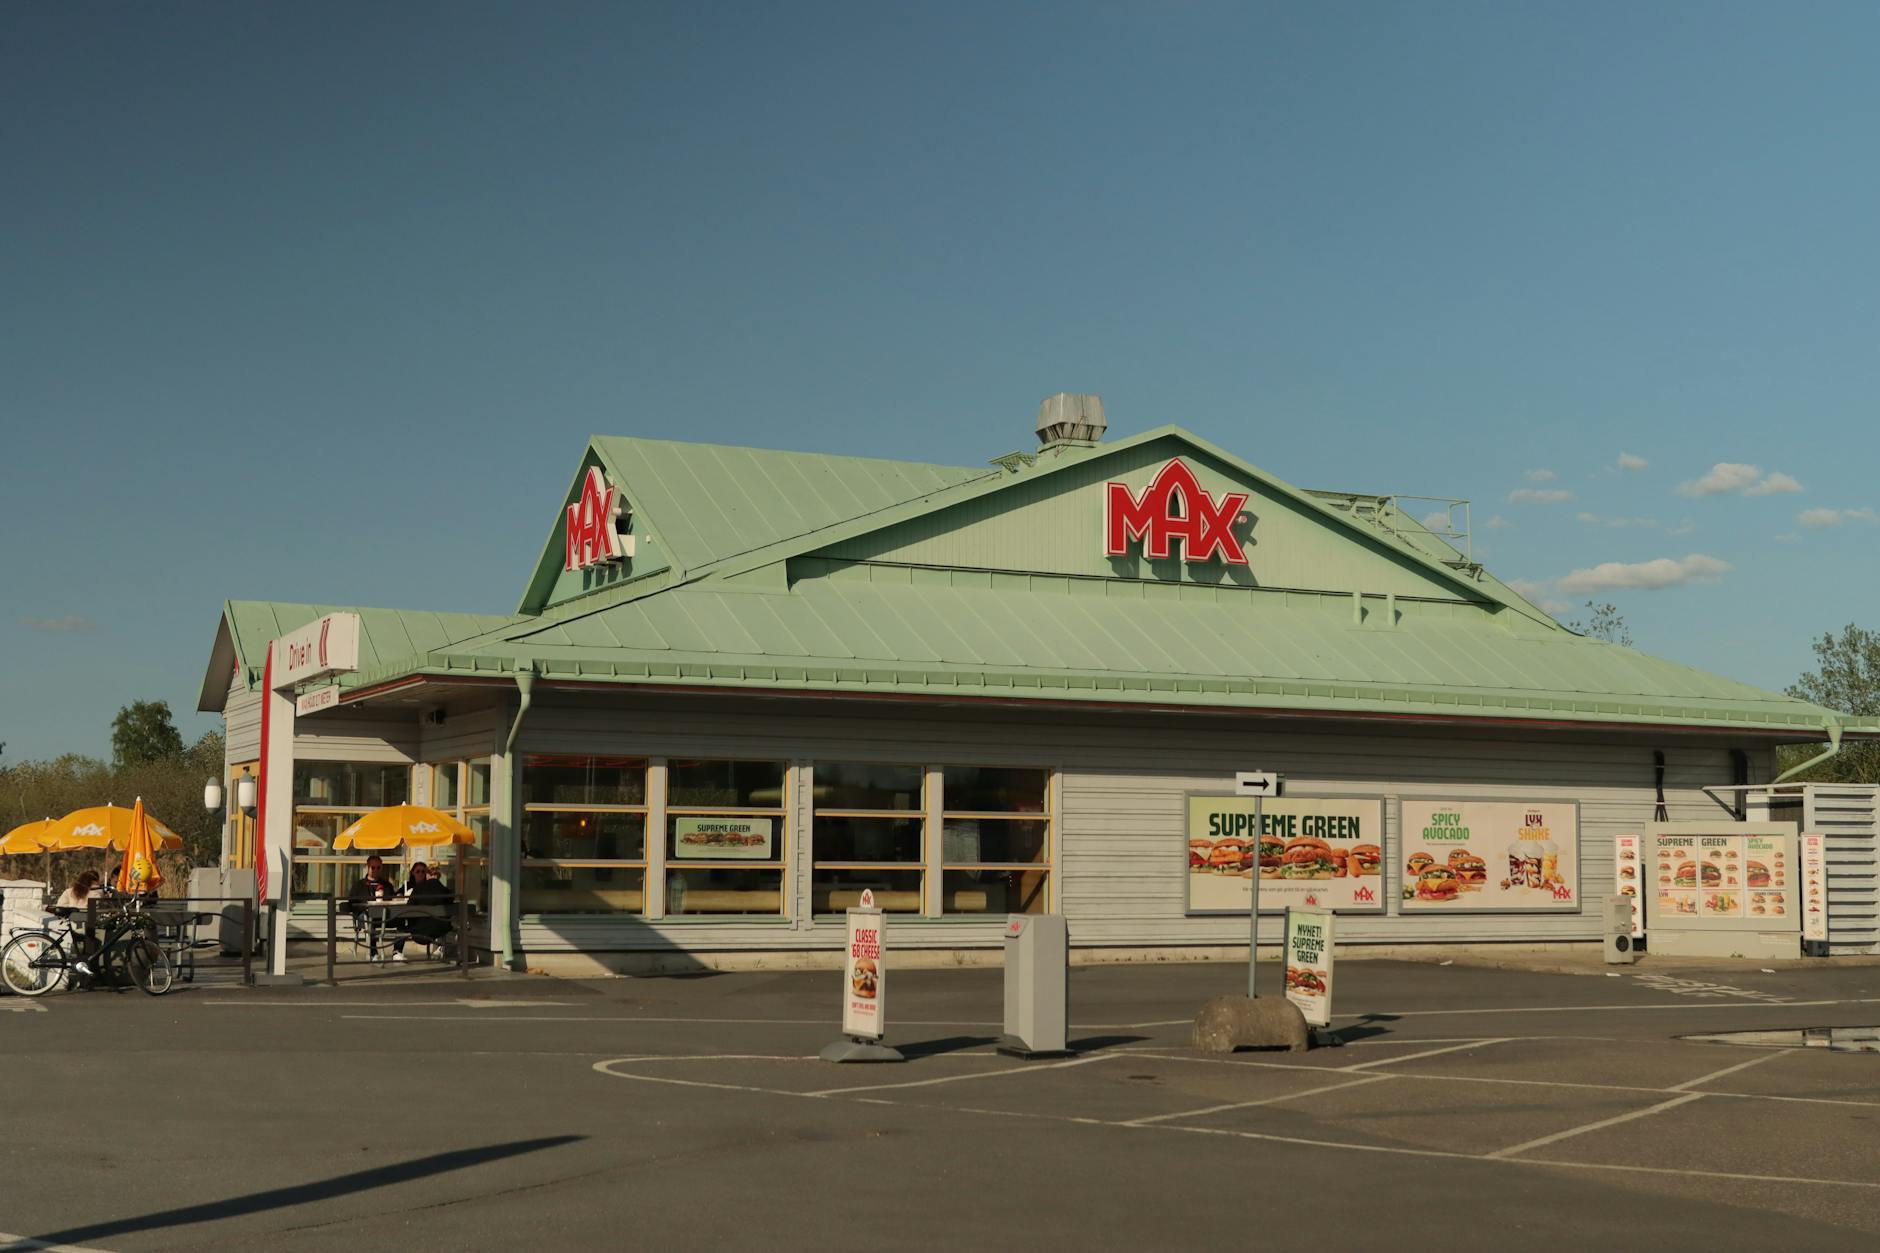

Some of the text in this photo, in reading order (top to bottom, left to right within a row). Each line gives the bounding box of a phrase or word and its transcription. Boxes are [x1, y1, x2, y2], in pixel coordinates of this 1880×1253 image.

[1106, 457, 1249, 565] MAX
[565, 467, 614, 572] MAX
[289, 642, 305, 671] Drive
[409, 820, 440, 834] MAX
[1209, 813, 1360, 839] SUPREME GREEN
[1431, 813, 1461, 826] SPICY
[72, 822, 105, 836] MAX
[697, 824, 751, 833] SUPREME GREEN
[1422, 827, 1470, 840] AVOCADO
[1657, 838, 1727, 847] SUPREME GREEN
[1354, 886, 1374, 901] MAX
[1553, 885, 1571, 900] MAX
[855, 928, 878, 944] CLASSIC
[1297, 924, 1322, 938] NYHET!
[1292, 937, 1325, 952] SUPREME
[861, 945, 880, 960] CHEESE
[1297, 950, 1319, 965] GREEN
